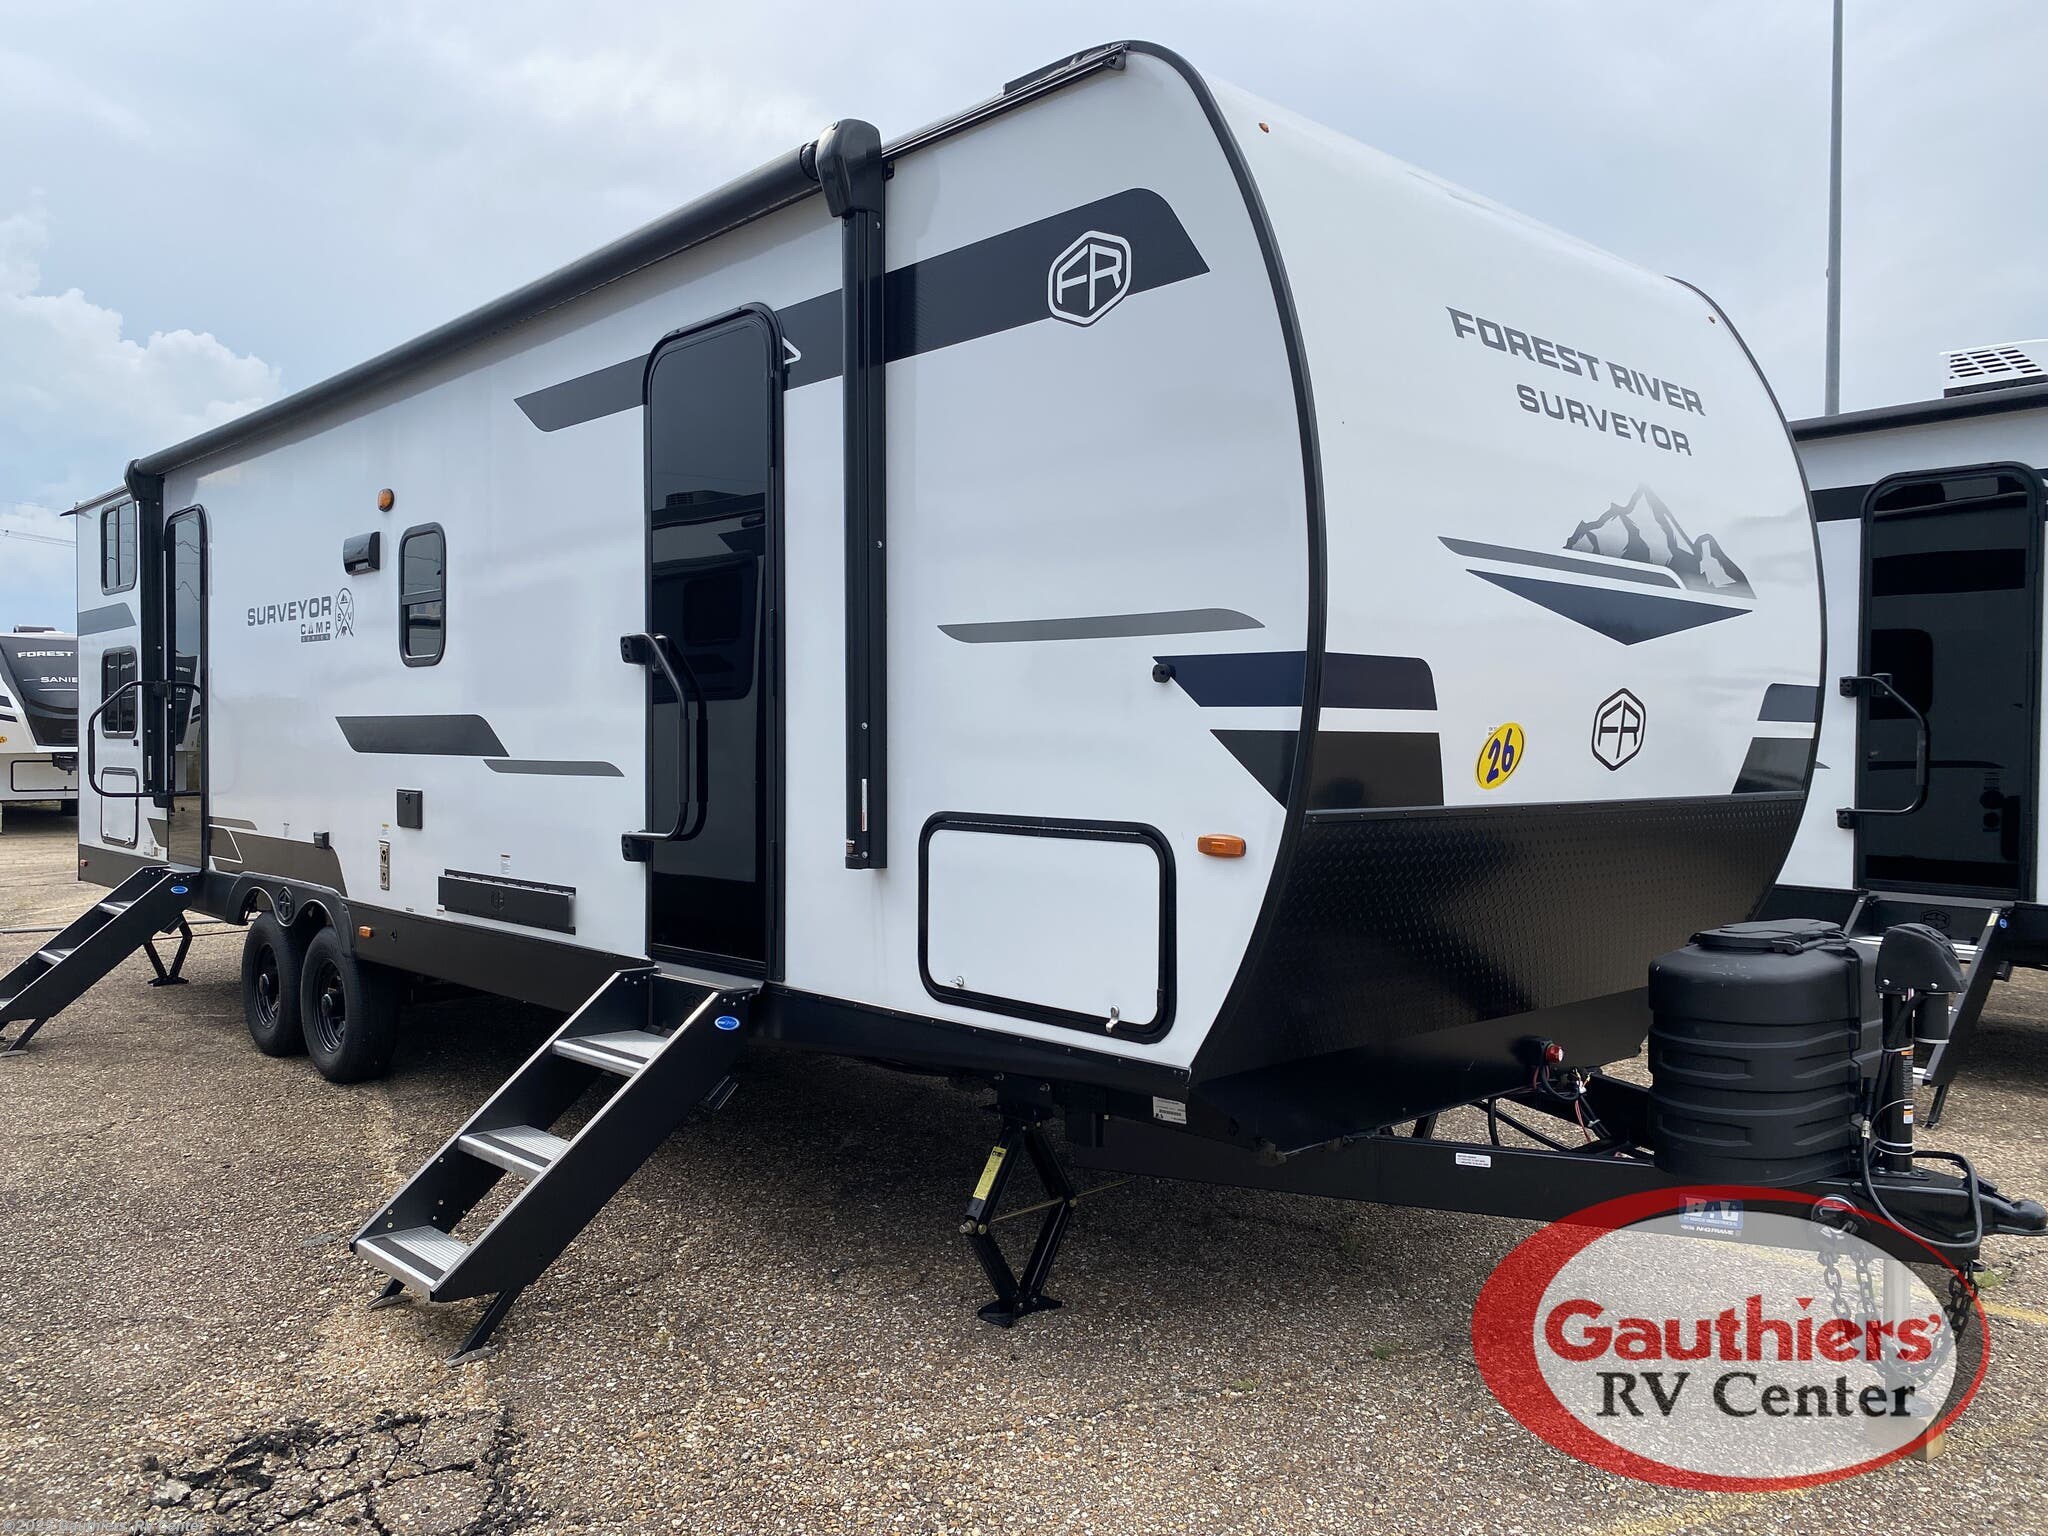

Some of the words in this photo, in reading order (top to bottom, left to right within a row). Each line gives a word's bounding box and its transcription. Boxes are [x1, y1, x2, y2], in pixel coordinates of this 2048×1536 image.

[1446, 306, 1599, 382] FOREST
[1605, 361, 1705, 416] RIVER
[1516, 383, 1692, 456] SURVEYOR
[247, 596, 331, 626] SURVEYOR
[301, 621, 331, 635] CAMP
[1487, 728, 1515, 784] 26
